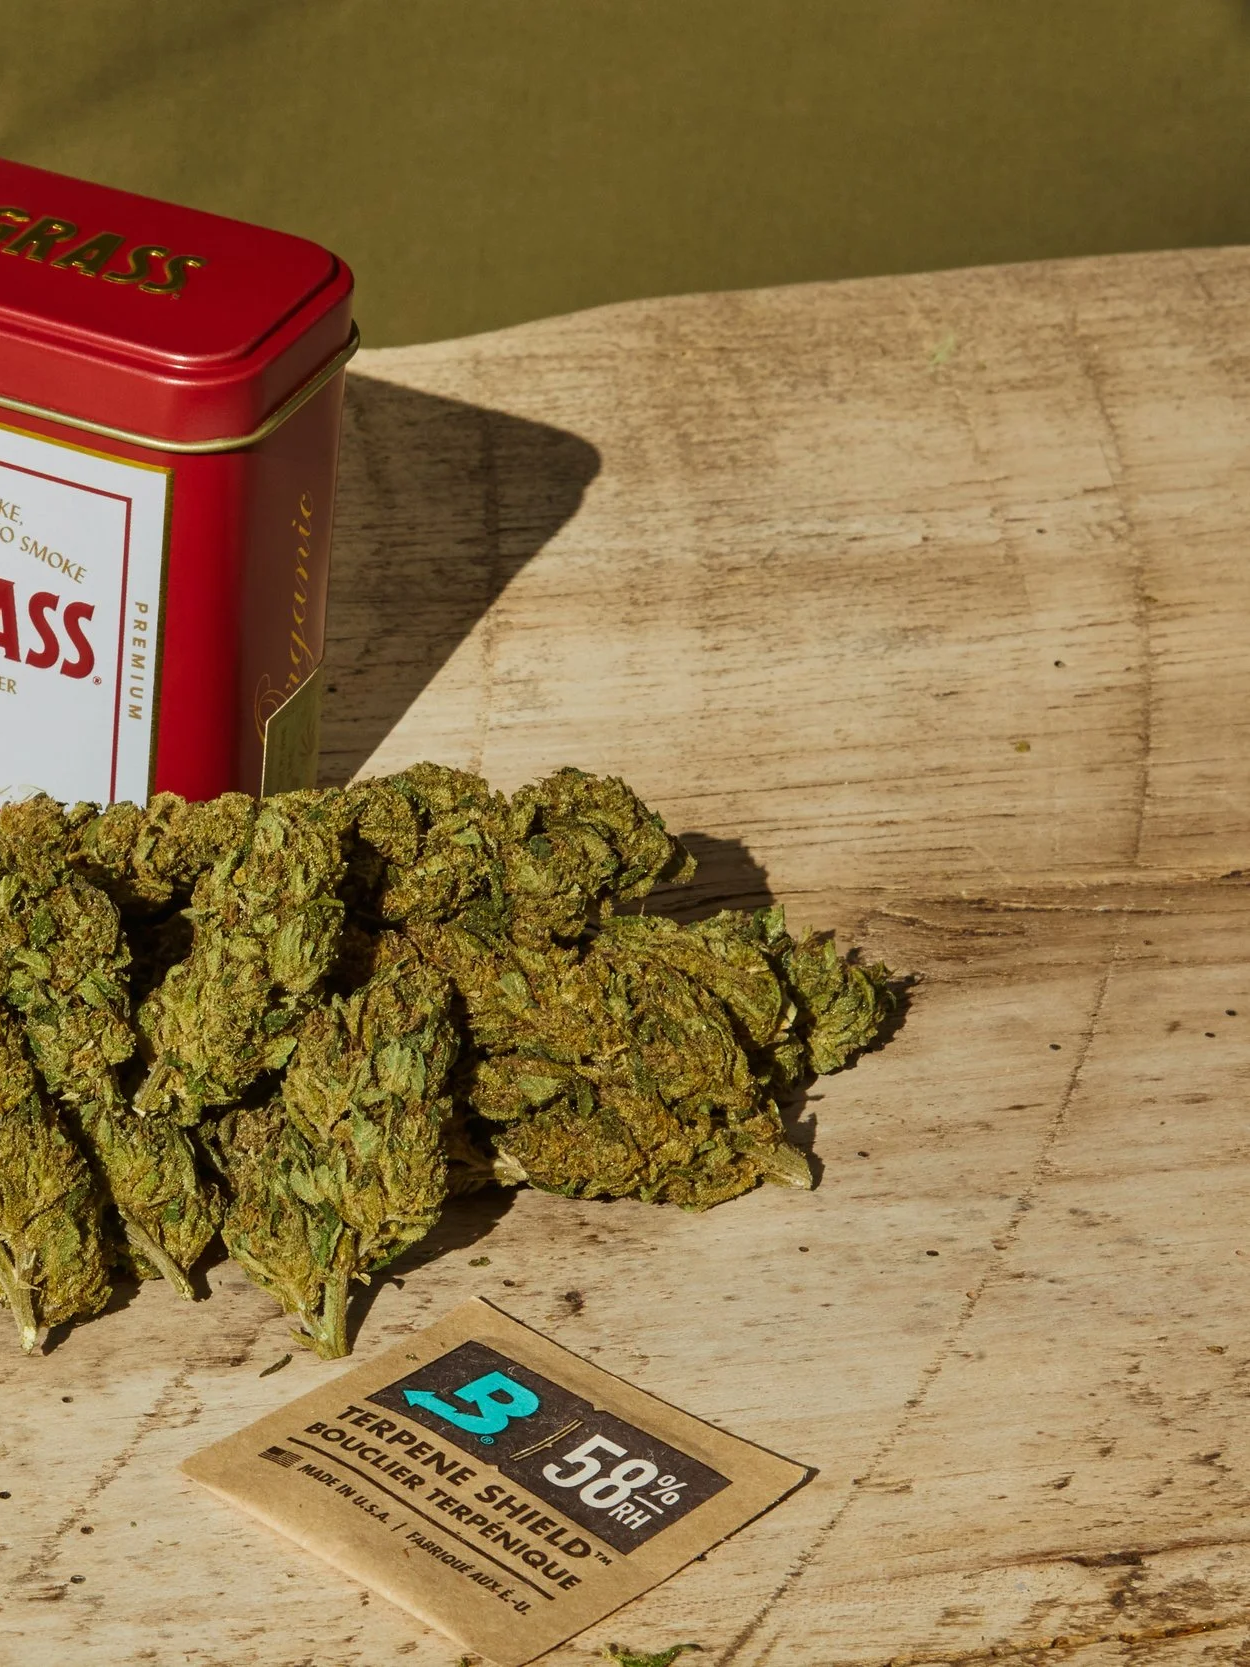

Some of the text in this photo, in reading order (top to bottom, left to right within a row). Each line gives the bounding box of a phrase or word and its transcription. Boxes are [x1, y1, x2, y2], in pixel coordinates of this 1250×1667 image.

[19, 536, 88, 584] SMOKE
[128, 601, 149, 720] PREMIUM
[336, 1405, 478, 1487] TERPENE
[297, 1463, 390, 1524] MADE IN U.S.A.
[303, 1421, 583, 1591] BOUCLIER TERPÉNIQUE
[608, 1502, 652, 1530] RH
[405, 1531, 475, 1574] FABRIQUÉ
[467, 1572, 503, 1592] AUX
